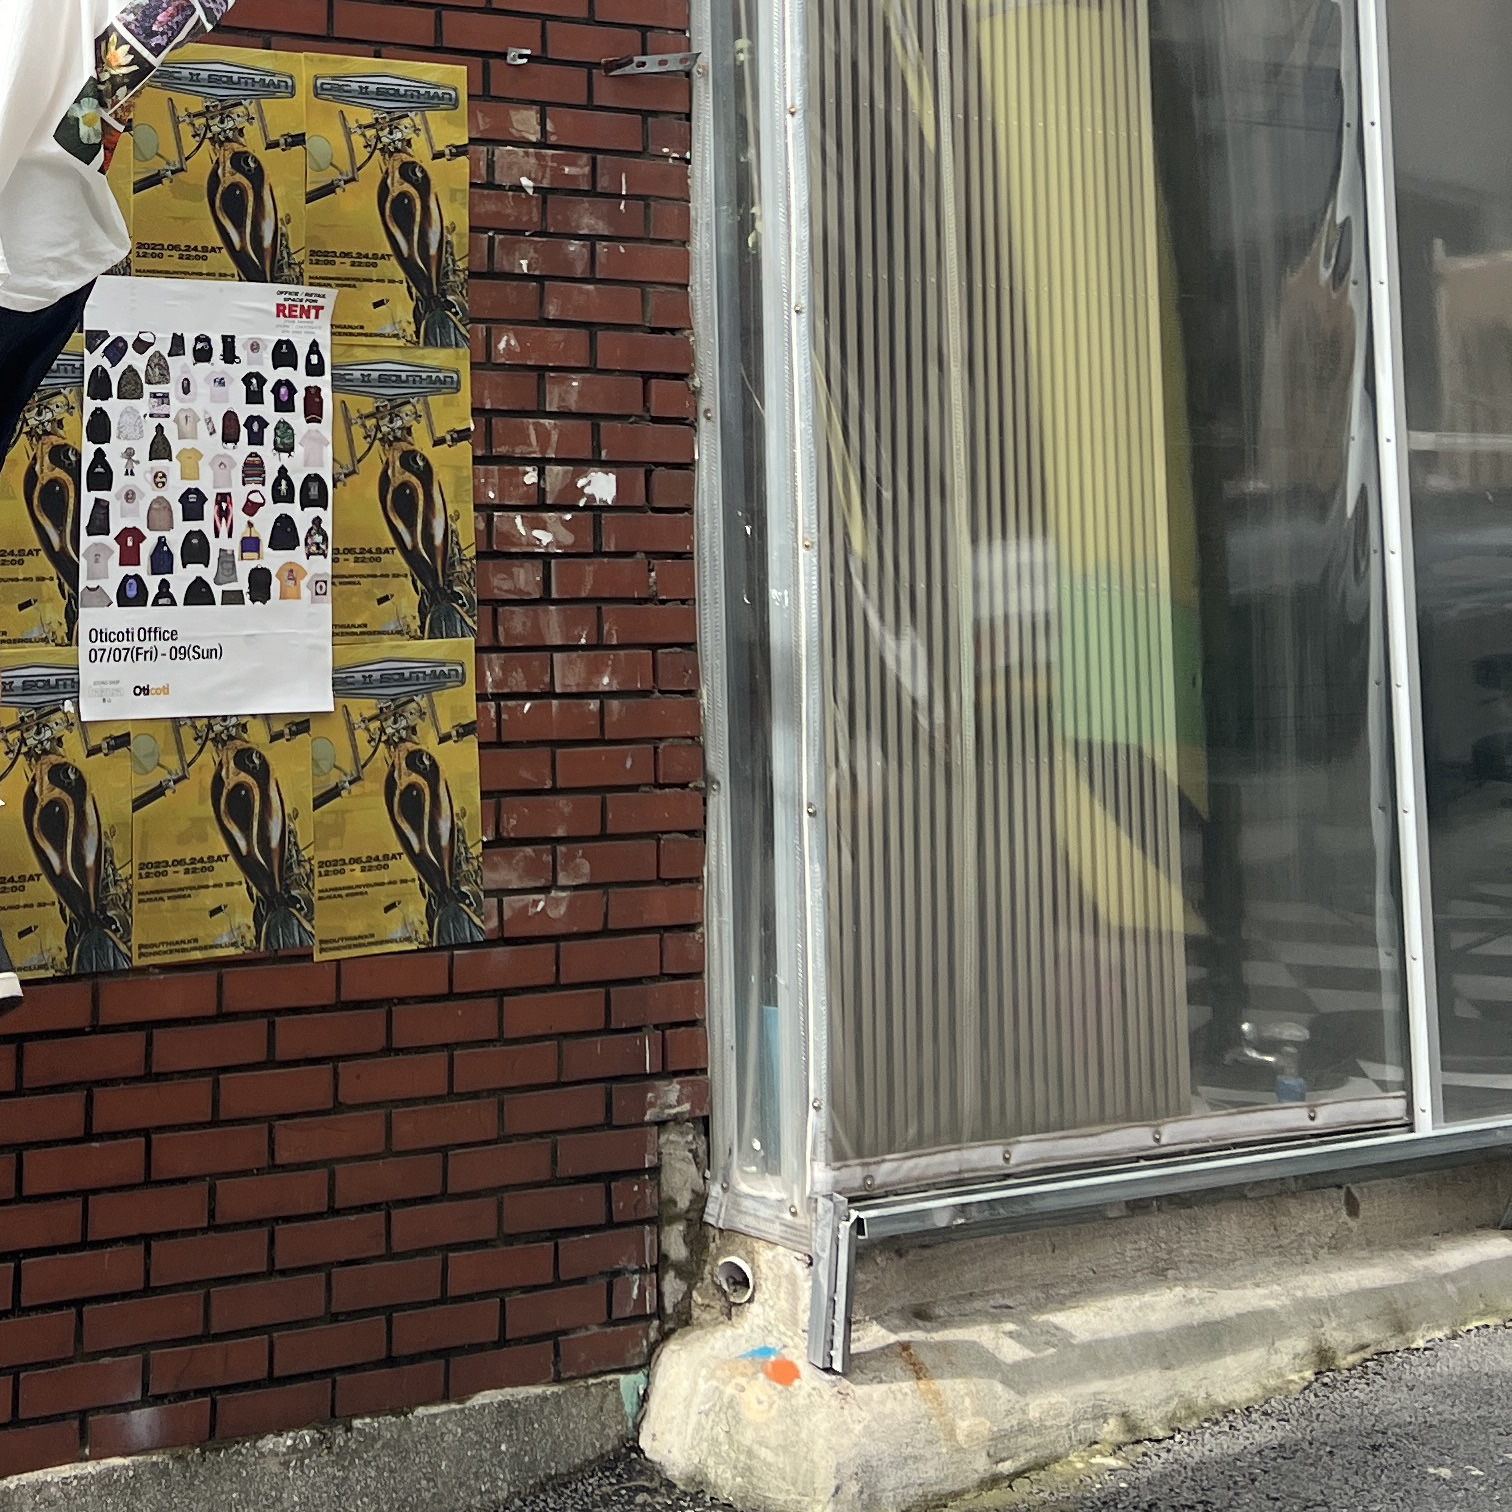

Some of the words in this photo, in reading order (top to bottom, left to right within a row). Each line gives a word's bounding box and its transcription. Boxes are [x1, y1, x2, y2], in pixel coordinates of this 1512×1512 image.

[276, 303, 325, 319] RENT
[89, 628, 134, 643] Oticoti
[137, 627, 178, 642] Office
[89, 645, 158, 663] 07/07(Fri)
[169, 643, 223, 661] 09(Sun)
